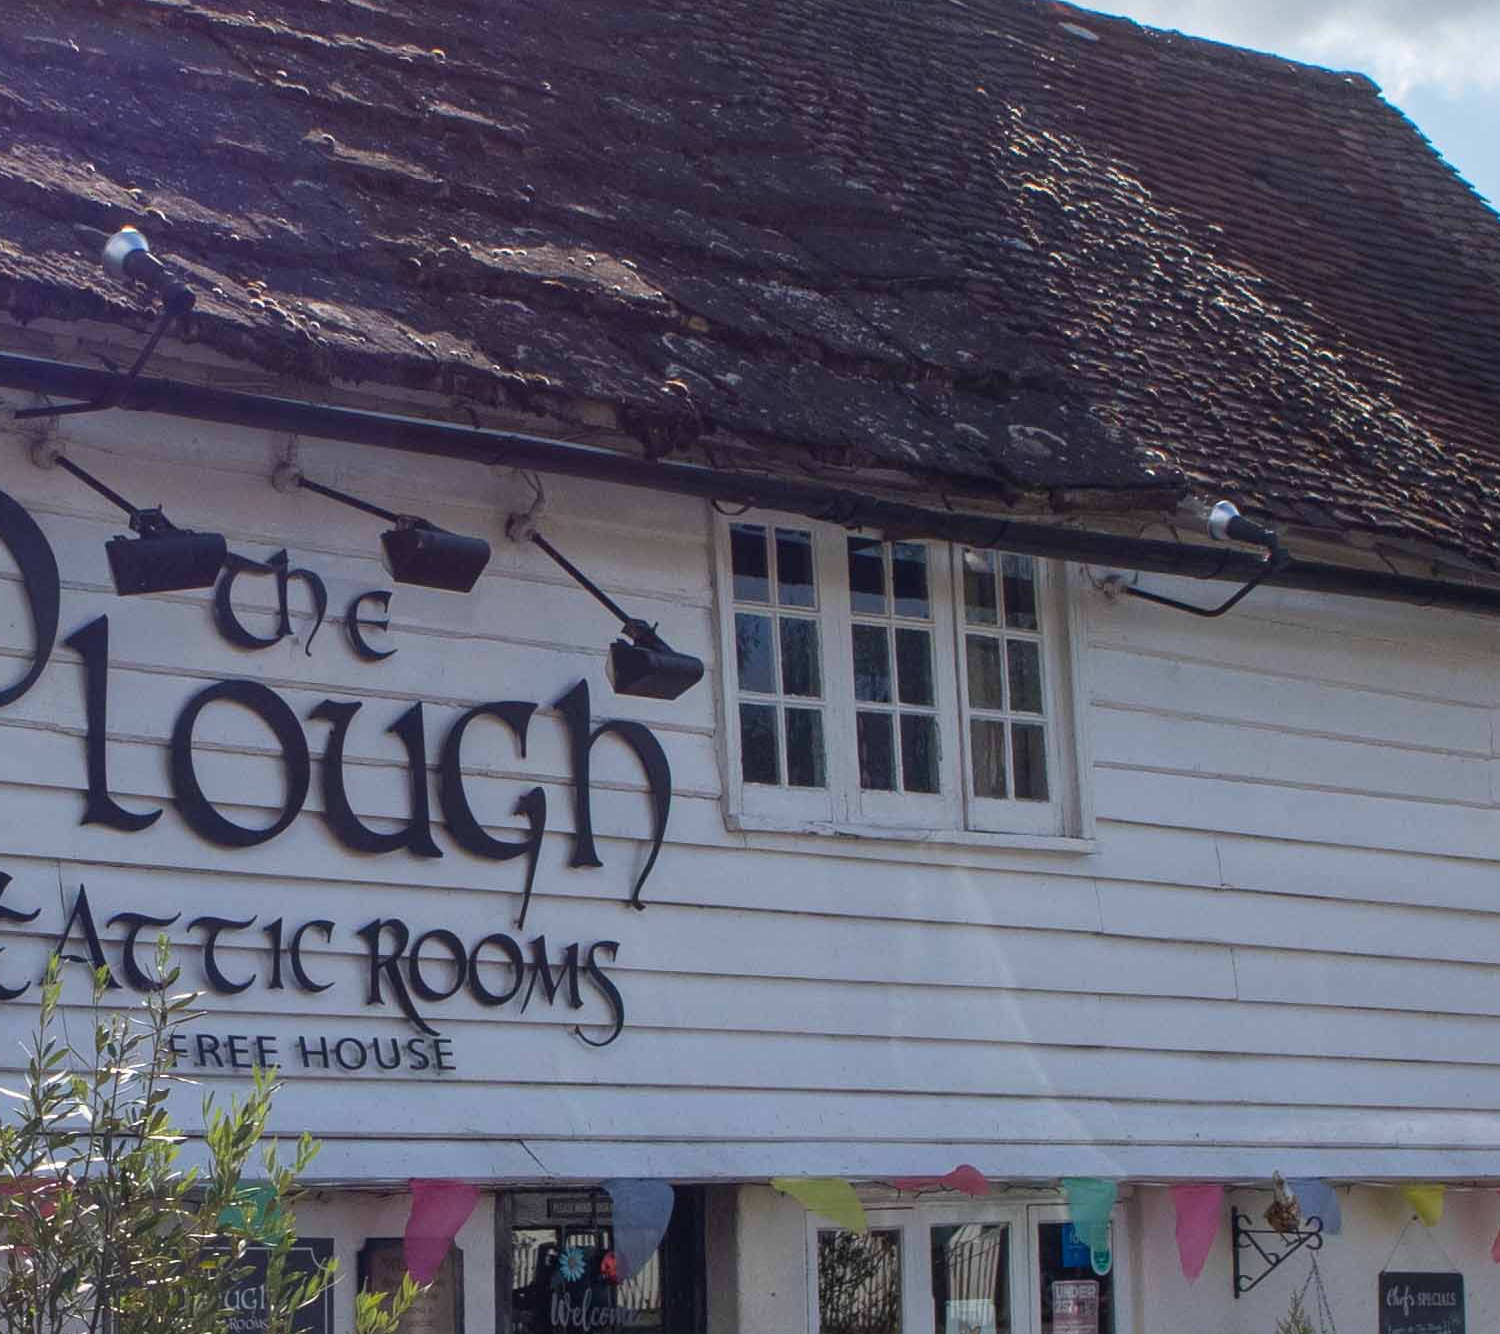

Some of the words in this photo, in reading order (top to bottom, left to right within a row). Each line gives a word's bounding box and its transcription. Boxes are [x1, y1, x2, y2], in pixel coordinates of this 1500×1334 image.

[39, 883, 337, 995] ATTIC
[356, 917, 625, 1047] ROOMS
[166, 1033, 281, 1070] FREE
[298, 1035, 457, 1072] HOUSE
[551, 1287, 641, 1332] Welcome
